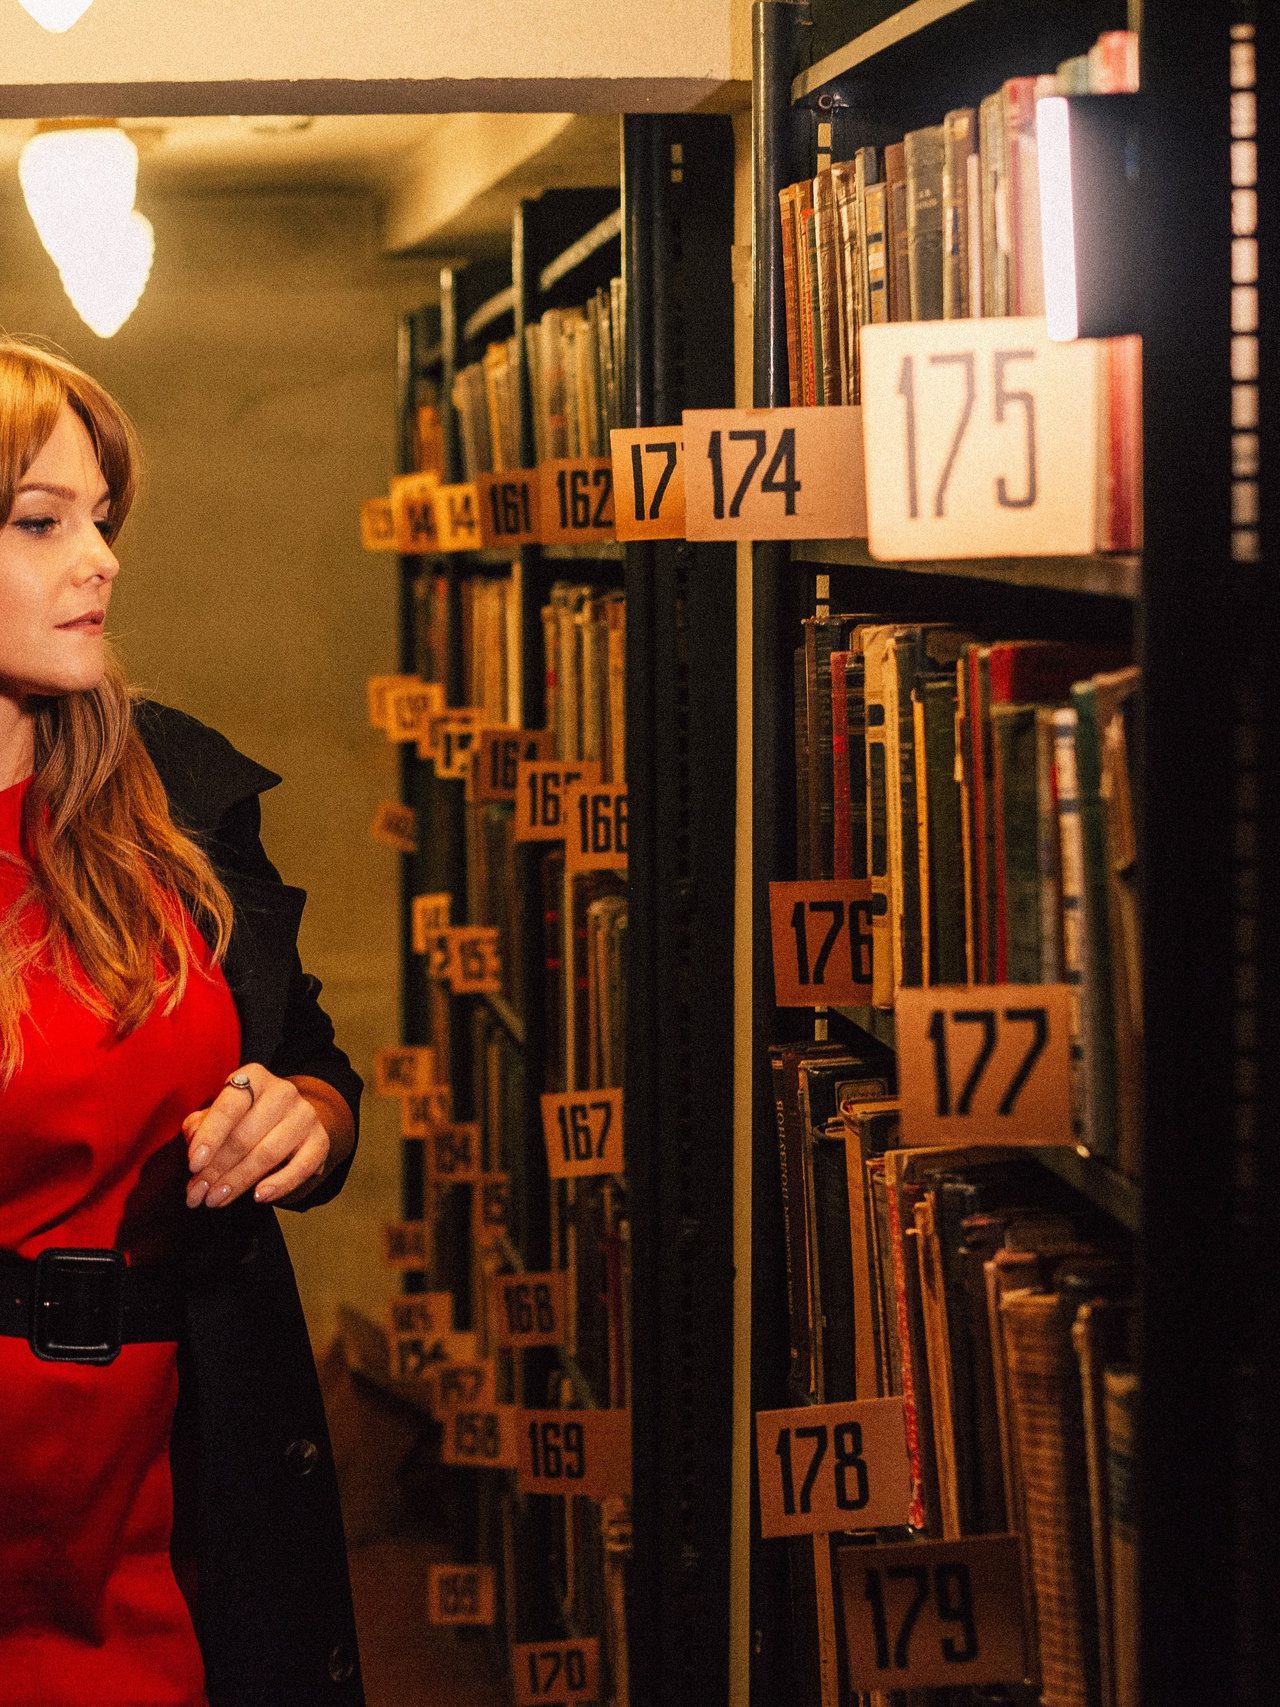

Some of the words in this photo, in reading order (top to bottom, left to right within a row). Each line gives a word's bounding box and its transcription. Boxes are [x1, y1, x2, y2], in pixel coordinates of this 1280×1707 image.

[707, 427, 801, 520] 174
[897, 349, 1039, 520] 175
[489, 481, 532, 536] 161
[557, 469, 613, 529] 162
[631, 441, 684, 521] 17
[791, 900, 873, 985] 176
[927, 1007, 1050, 1117] 177
[557, 1101, 613, 1162] 167
[502, 1282, 556, 1335] 168
[527, 1421, 586, 1480] 169
[775, 1420, 870, 1516] 178
[864, 1561, 979, 1671] 179
[528, 1648, 588, 1695] 170
